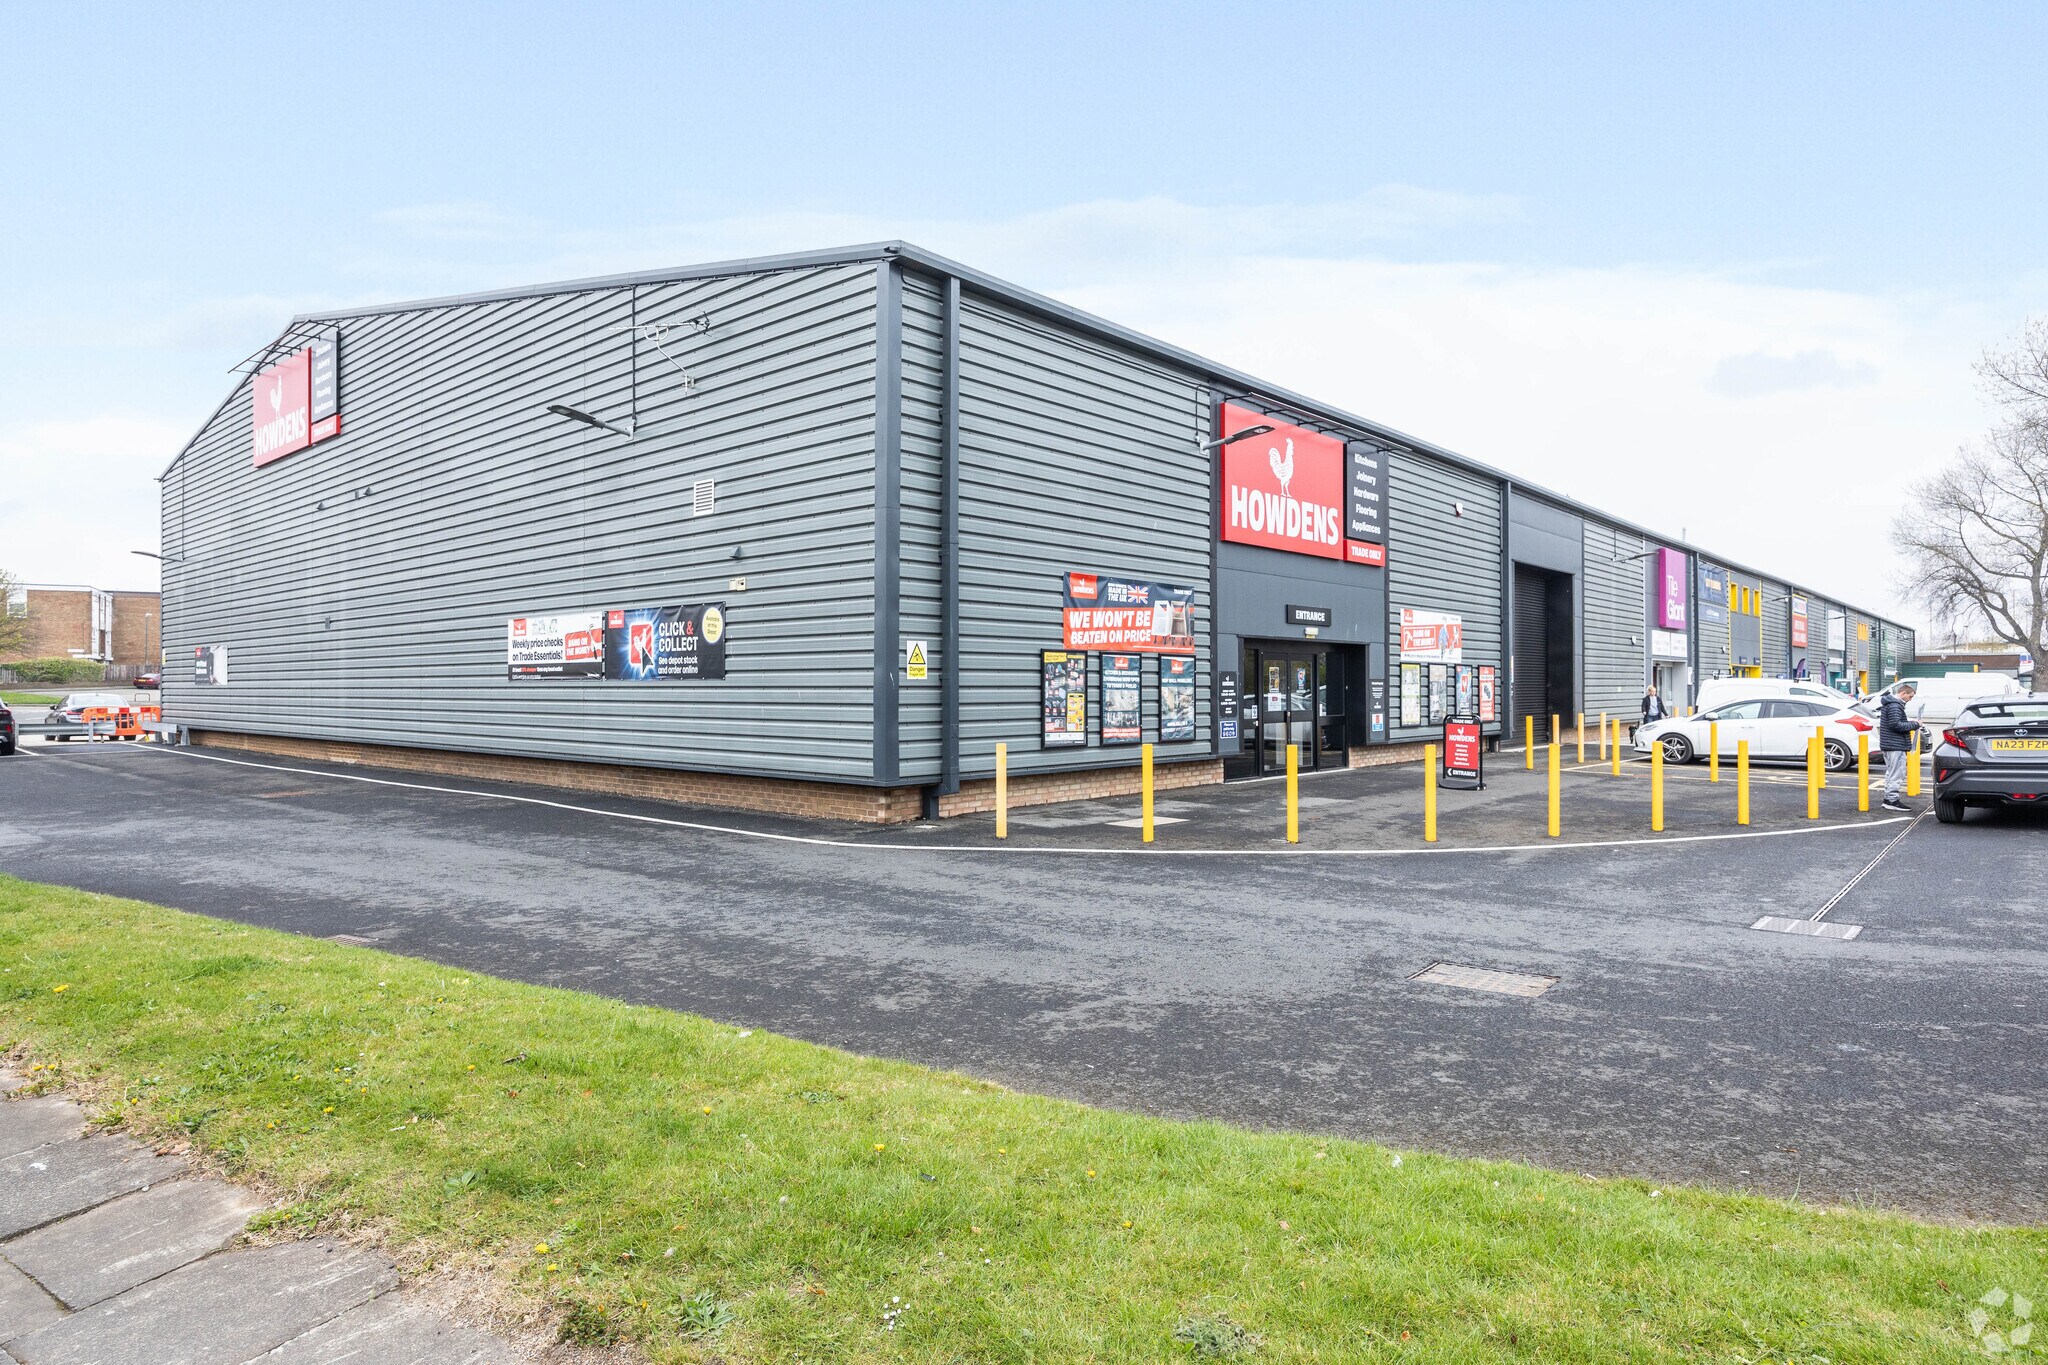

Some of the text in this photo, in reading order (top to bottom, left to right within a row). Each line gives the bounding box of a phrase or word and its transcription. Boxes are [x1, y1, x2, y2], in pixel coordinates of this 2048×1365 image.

[255, 406, 306, 457] HOWDENS
[1354, 453, 1378, 469] Kitchens
[1356, 470, 1377, 486] Joinery
[1353, 486, 1380, 502] Hardware
[1231, 484, 1339, 546] HOWDENS
[1355, 503, 1378, 519] Flooring
[1351, 519, 1381, 535] Appliances
[1351, 545, 1382, 561] TRADE ONLY
[1073, 586, 1095, 594] HOWDENS
[1108, 587, 1121, 595] MADE
[1666, 574, 1679, 598] Tile
[1108, 594, 1119, 602] THE
[1295, 609, 1325, 622] ENTRANCE
[1667, 598, 1685, 622] Giant
[1069, 610, 1151, 629] WE WON'T BE
[658, 620, 694, 637] CLICK &
[512, 637, 563, 650] Weekly price checks
[658, 636, 698, 652] COLLECT
[1070, 629, 1151, 645] BEATEN ON PRICE
[512, 654, 519, 662] on
[519, 652, 534, 661] Trade
[658, 655, 698, 666] See depot stock
[658, 665, 698, 675] and order online
[1448, 734, 1476, 743] HOWDENS
[1996, 740, 2048, 749] NA23 FZP
[1452, 769, 1477, 778] ENTRANCE
